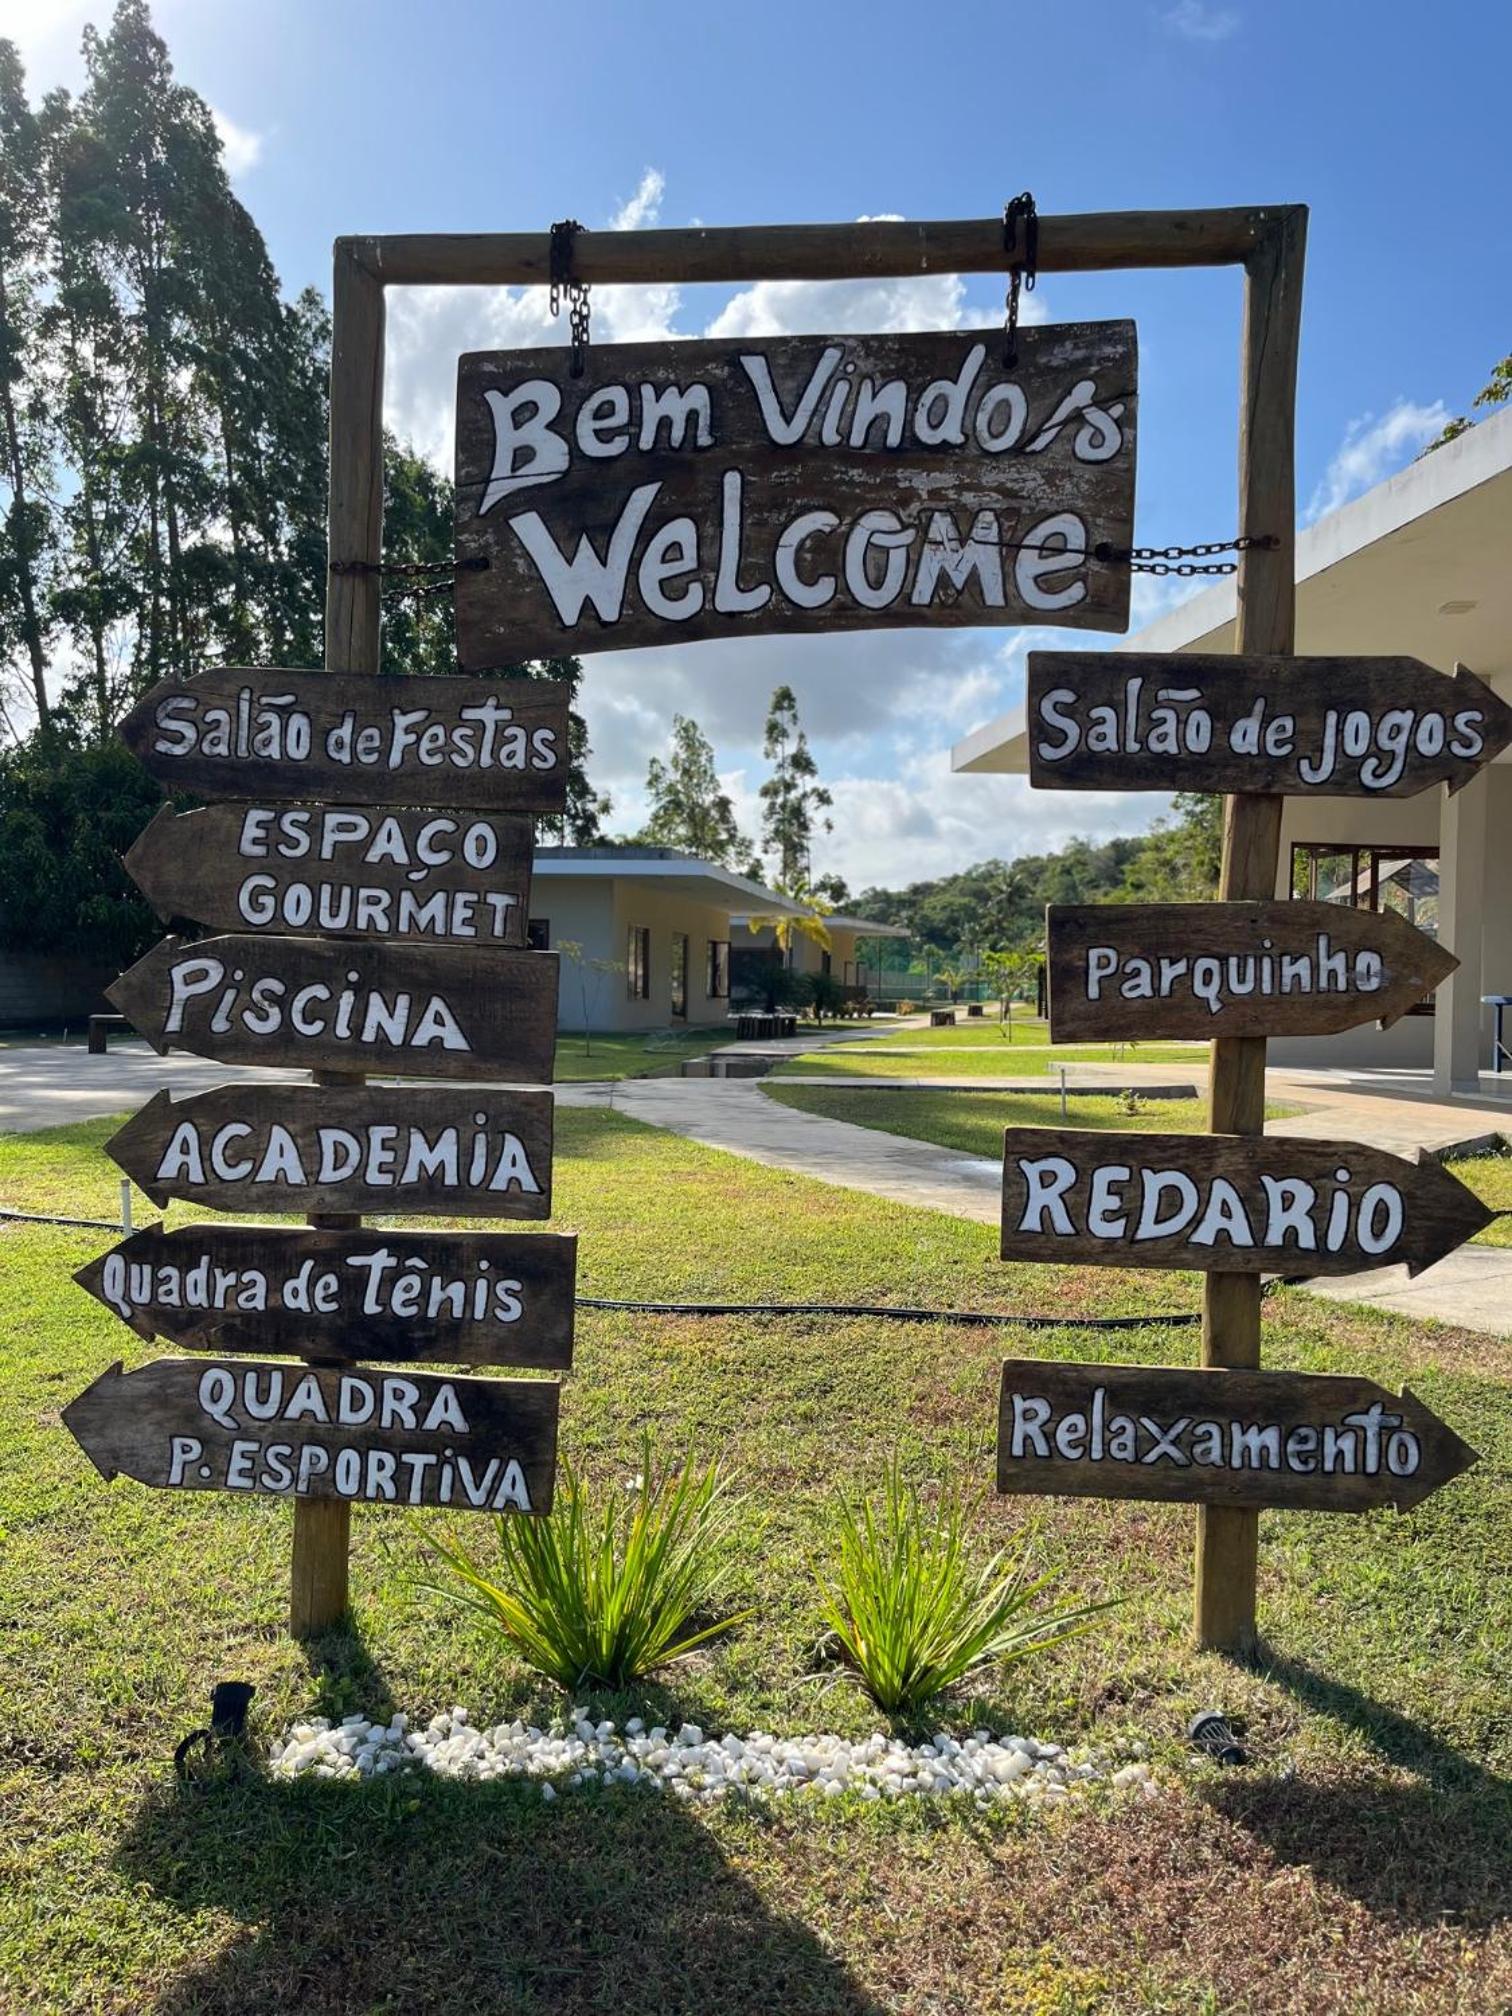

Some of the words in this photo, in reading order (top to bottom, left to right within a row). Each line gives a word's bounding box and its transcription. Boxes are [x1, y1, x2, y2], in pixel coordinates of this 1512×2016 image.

[479, 379, 713, 515] Bem
[154, 687, 311, 760] Salão
[326, 710, 381, 766] de
[388, 696, 557, 771] Festas
[1037, 677, 1212, 762] Salão
[1229, 697, 1295, 757] de
[239, 808, 498, 882] ESPAÇO
[238, 873, 520, 938] GOURMET
[1086, 933, 1384, 1015] Parquinho
[102, 1253, 267, 1319] Quadra
[283, 1259, 339, 1314] de
[346, 1248, 523, 1322] Tênis
[199, 1367, 470, 1433] QUADRA
[1012, 1387, 1420, 1477] Relaxamento
[169, 1437, 213, 1486] P.
